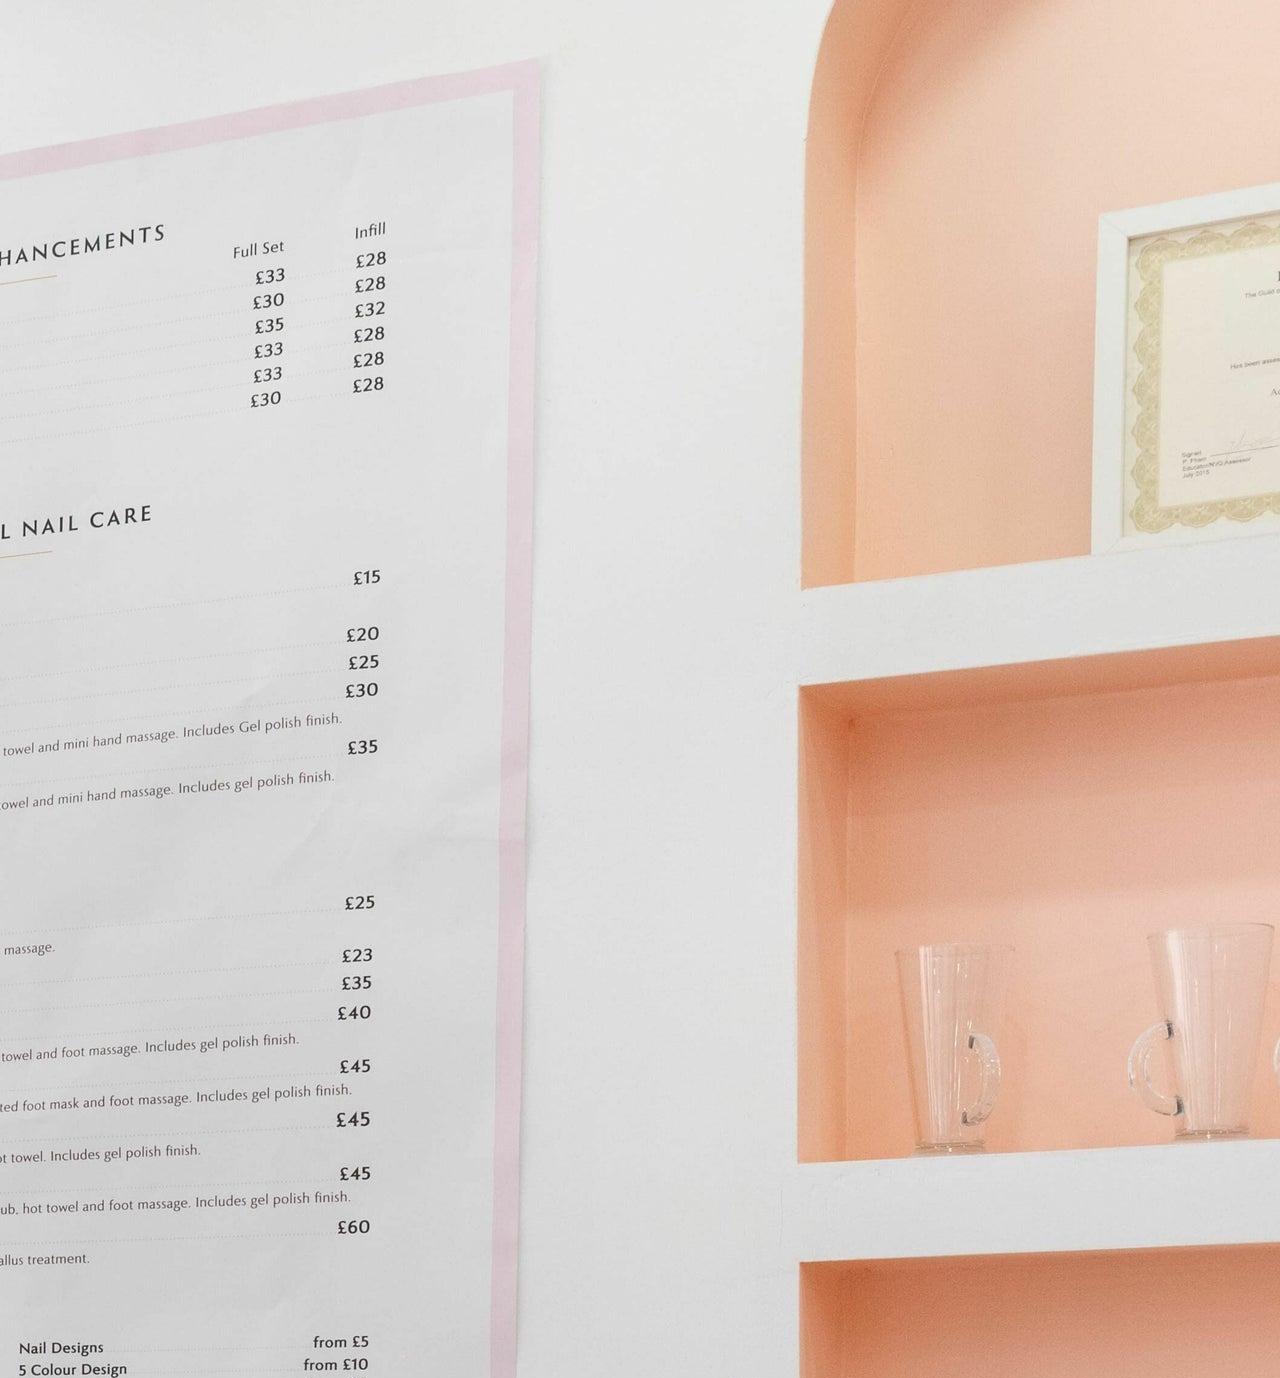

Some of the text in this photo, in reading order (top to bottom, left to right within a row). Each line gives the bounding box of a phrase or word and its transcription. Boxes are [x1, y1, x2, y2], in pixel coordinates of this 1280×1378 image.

[355, 221, 386, 240] Infill
[233, 241, 285, 259] Full Set
[356, 251, 387, 269] £28
[255, 267, 286, 285] £33
[355, 275, 386, 294] £28
[253, 292, 285, 310] £30
[354, 300, 386, 319] £32
[255, 317, 284, 335] £35
[353, 325, 385, 344] £28
[254, 341, 283, 359] £33
[353, 351, 385, 369] £28
[253, 366, 282, 384] £33
[352, 376, 384, 394] £28
[250, 390, 282, 409] £30
[22, 515, 79, 537] NAIL
[89, 504, 151, 529] CARE
[353, 569, 381, 586] £15
[346, 626, 379, 643] £20
[348, 654, 379, 671] £25
[345, 682, 379, 699] £30
[345, 894, 376, 911] £25
[341, 947, 373, 964] £23
[339, 1166, 371, 1182] £45
[19, 1341, 104, 1357] Nail Designs
[312, 1335, 369, 1349] from £5
